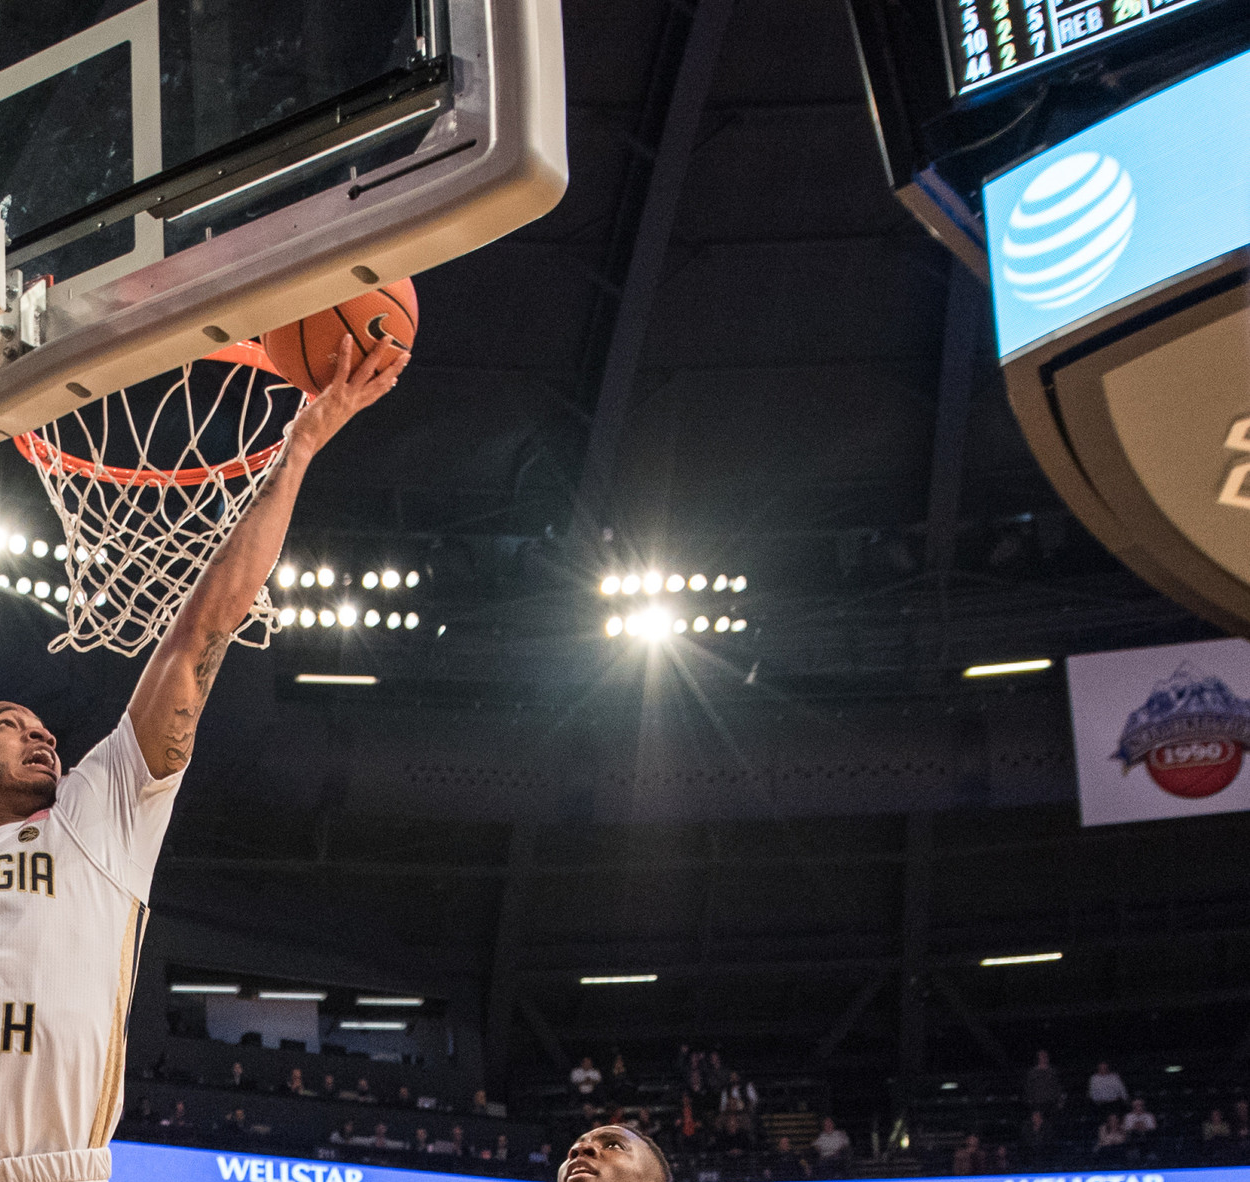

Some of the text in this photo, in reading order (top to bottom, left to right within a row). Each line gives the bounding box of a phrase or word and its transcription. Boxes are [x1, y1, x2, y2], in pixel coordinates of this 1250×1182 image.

[961, 28, 989, 59] 10
[996, 17, 1014, 46] 2
[1058, 5, 1104, 45] REB
[964, 29, 1047, 82] 44 2 7
